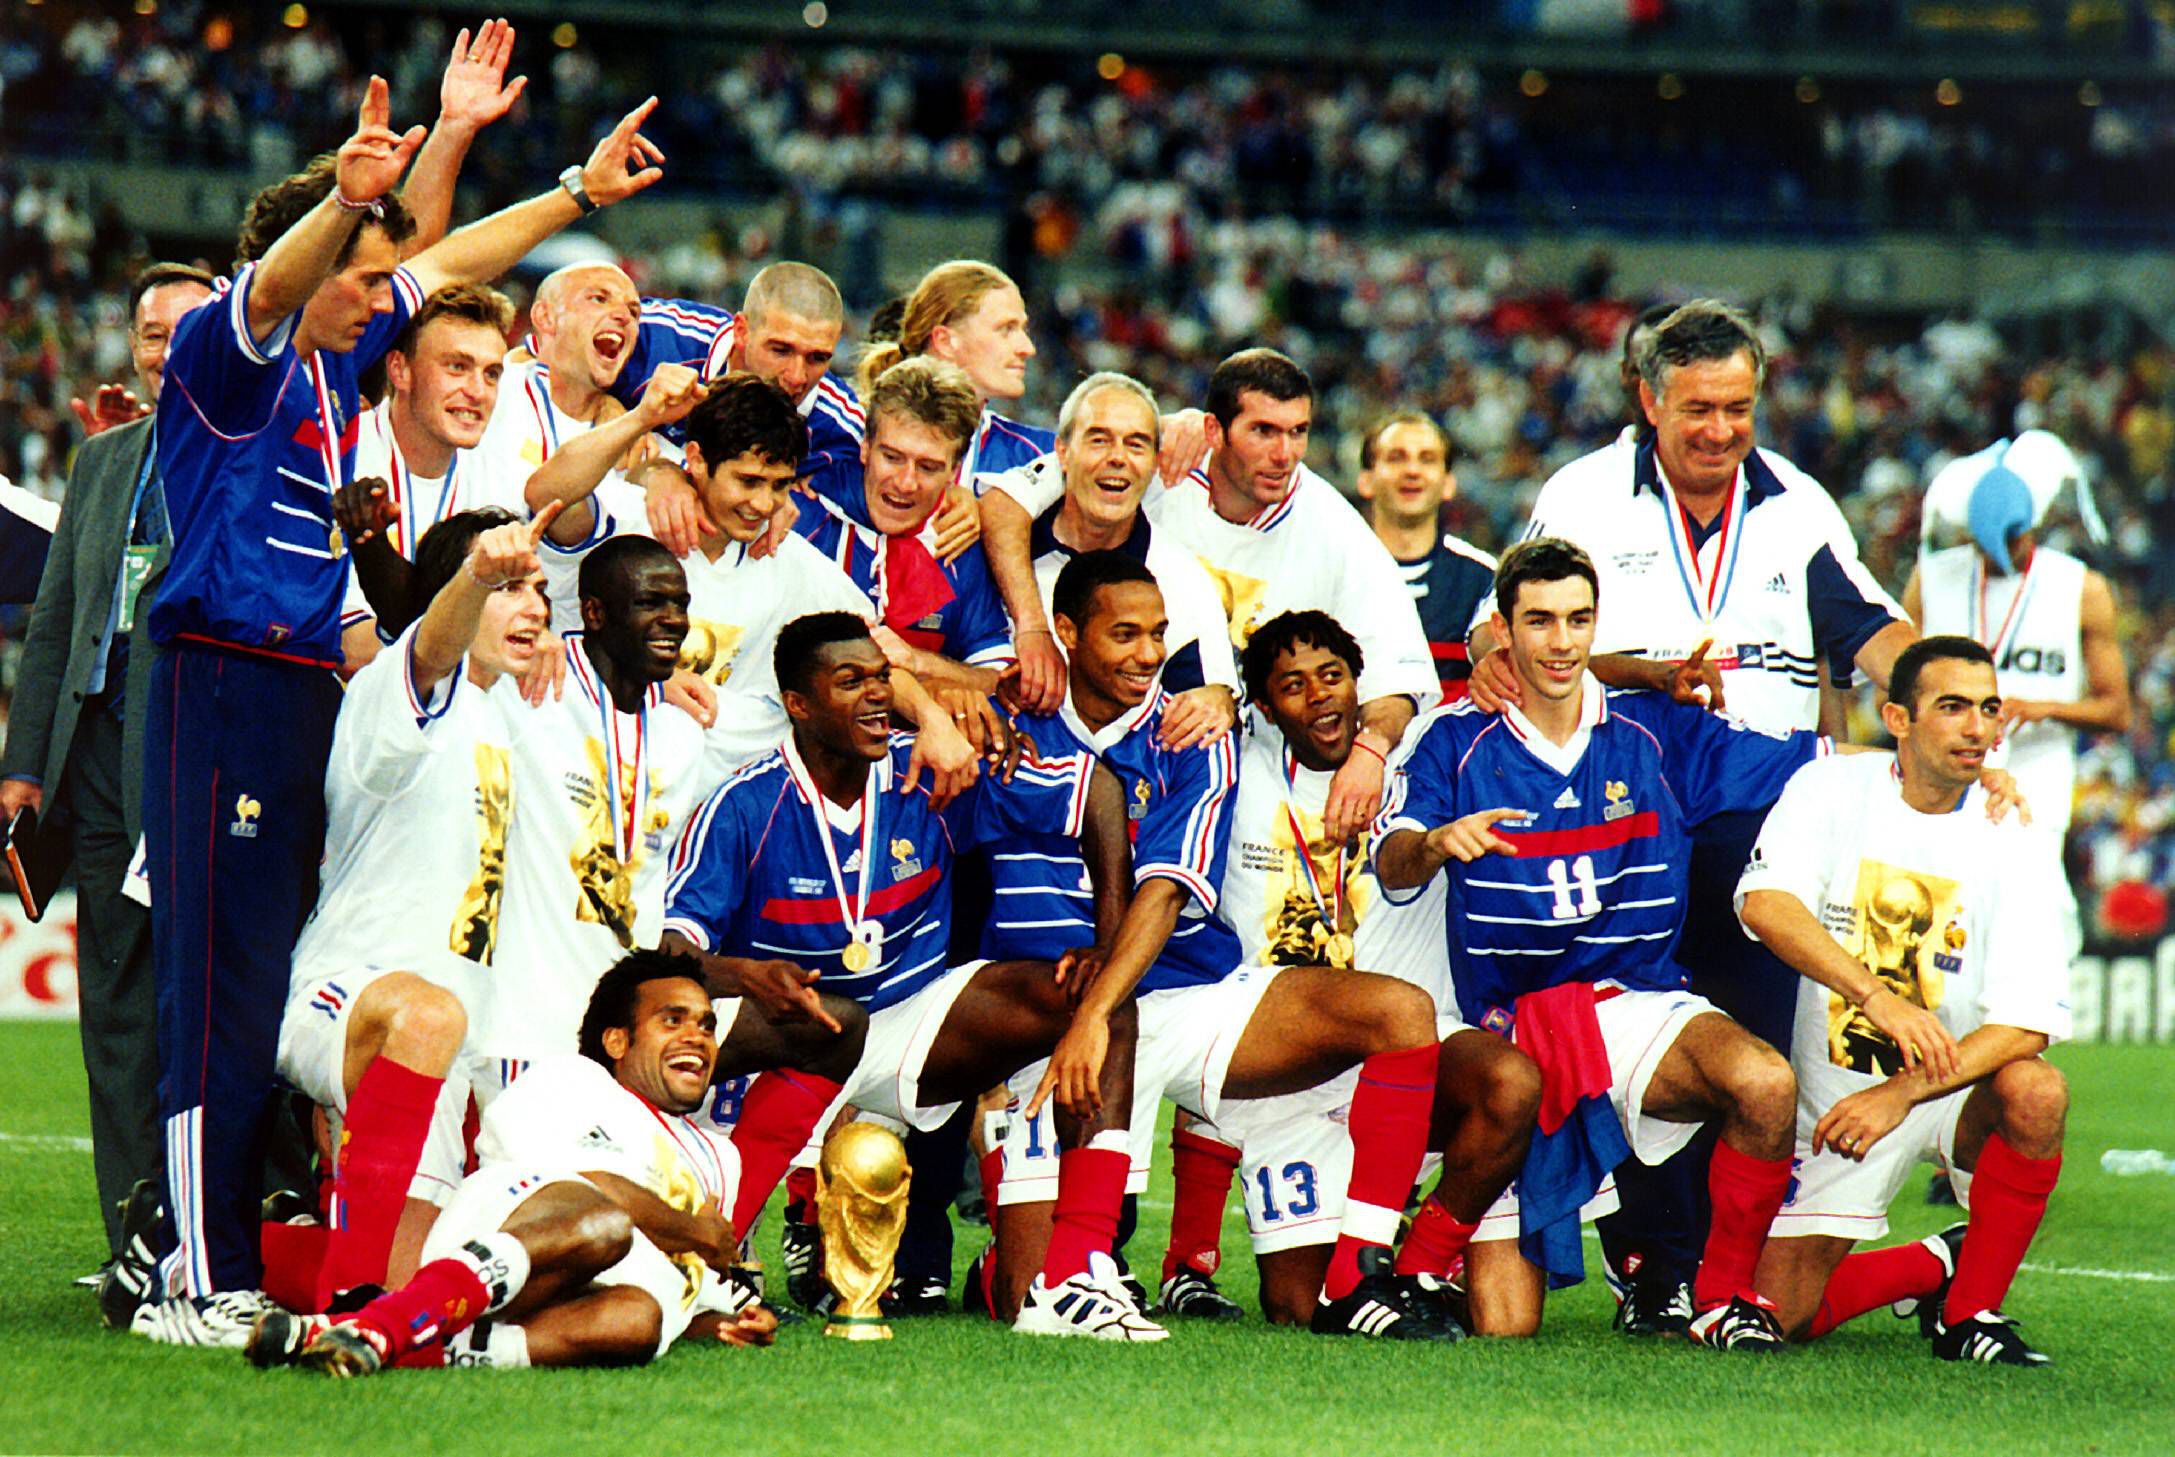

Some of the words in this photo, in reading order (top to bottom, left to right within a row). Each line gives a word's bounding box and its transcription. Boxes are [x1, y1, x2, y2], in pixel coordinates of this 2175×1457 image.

[1242, 842, 1286, 856] FRANCE
[1547, 855, 1602, 919] 11
[710, 1076, 750, 1127] 8
[1256, 1160, 1320, 1223] 13
